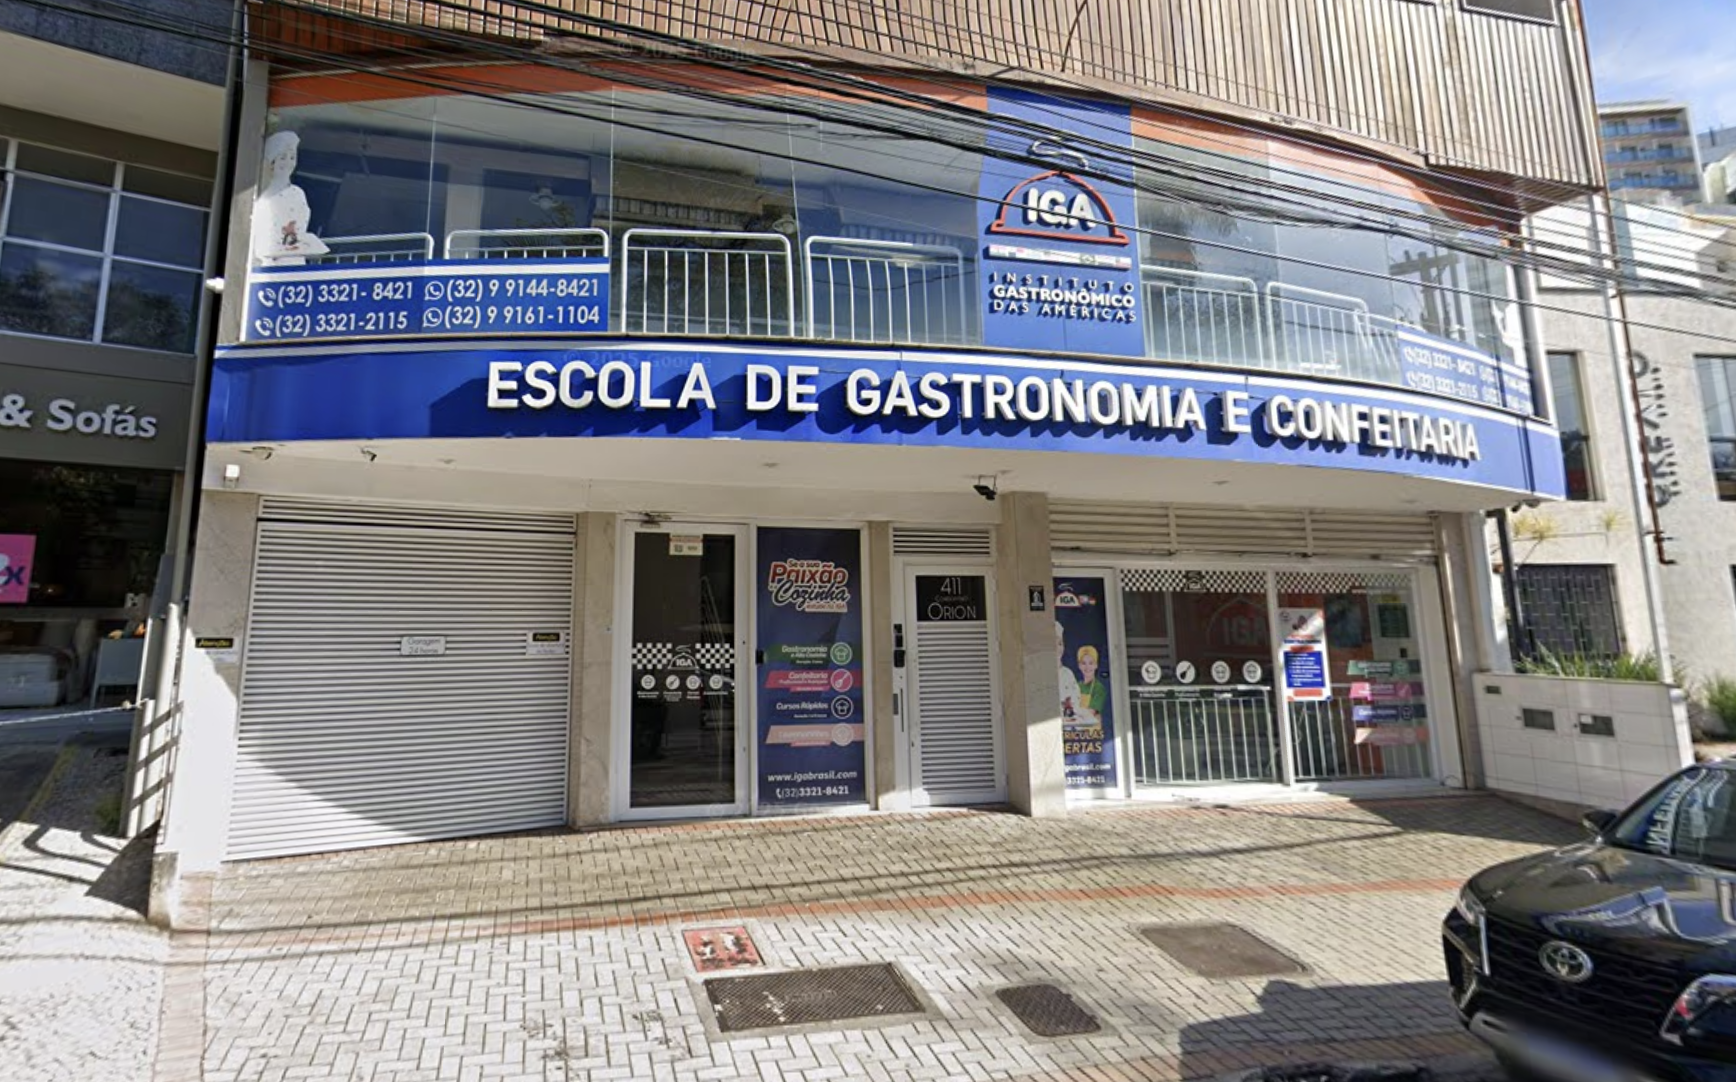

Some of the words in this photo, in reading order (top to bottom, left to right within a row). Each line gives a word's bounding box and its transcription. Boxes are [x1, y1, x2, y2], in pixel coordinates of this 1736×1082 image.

[1027, 188, 1096, 228] IGA
[278, 283, 313, 308] (32)
[318, 284, 367, 303] 3321-
[372, 282, 413, 301] 8421
[447, 279, 482, 302] (32)
[489, 281, 499, 298] 9
[505, 279, 599, 298] 9144-8421
[994, 272, 1135, 293] INSTITUTO
[993, 285, 1136, 308] GASTRONÔMICO
[275, 313, 310, 337] (32)
[315, 311, 408, 332] 3321-2115
[444, 307, 480, 329] (32)
[487, 308, 497, 325] 9
[504, 306, 600, 325] 9161-1104
[994, 300, 1030, 313] DAS
[1041, 303, 1137, 322] AMÉRICAS
[46, 399, 158, 439] Sofás
[487, 360, 717, 410] ESCOLA
[746, 363, 819, 412] DE
[846, 369, 1207, 431] GASTRONOMIA
[1221, 391, 1251, 433] E
[1266, 395, 1481, 461] CONFEITARIA
[770, 562, 847, 585] Paixão
[774, 580, 848, 609] Cozinha
[940, 577, 962, 595] 411
[1059, 595, 1076, 604] IGA
[676, 659, 693, 667] IGA
[776, 703, 800, 711] Cursos
[801, 702, 829, 712] Rápidos
[1065, 741, 1103, 754] ERTAS
[768, 770, 858, 783] www.igabrasil.com
